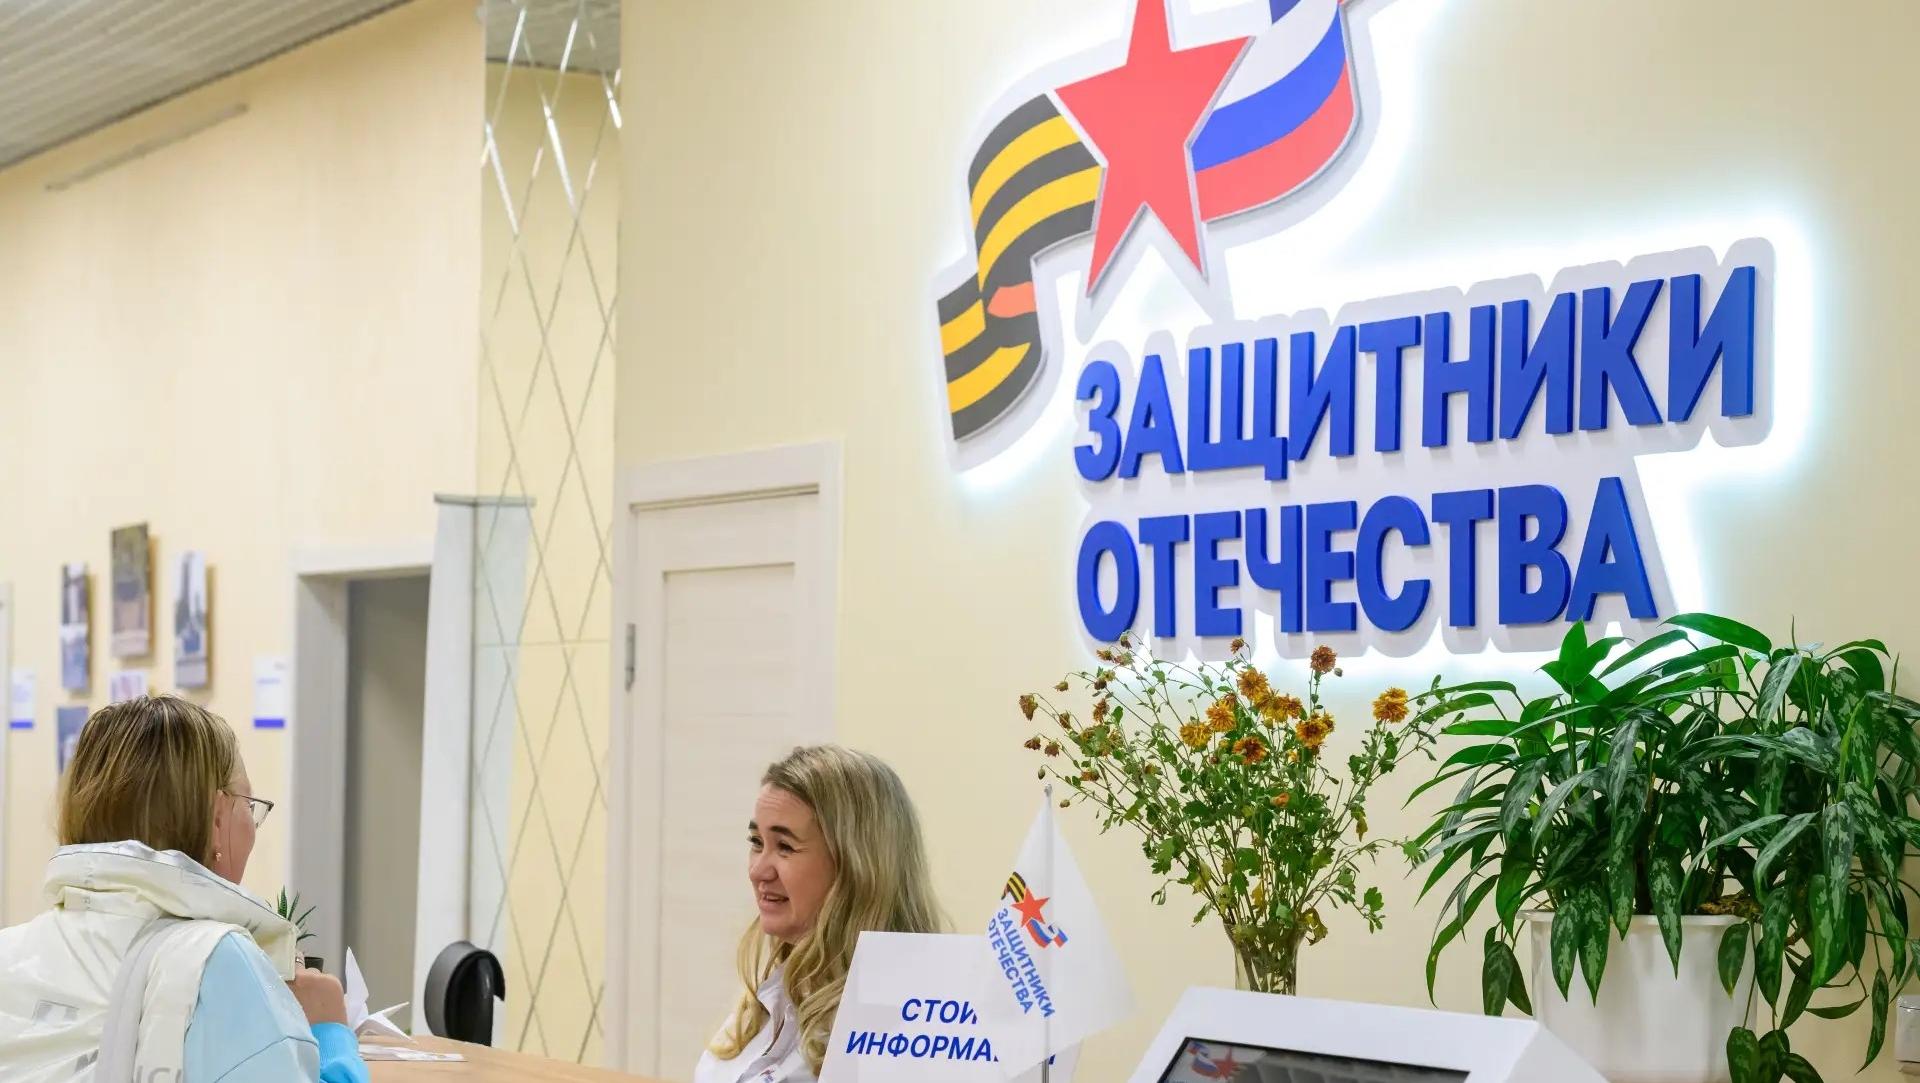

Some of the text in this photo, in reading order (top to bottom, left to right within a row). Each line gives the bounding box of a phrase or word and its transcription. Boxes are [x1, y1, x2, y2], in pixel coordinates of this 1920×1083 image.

[1074, 265, 1755, 482] ЗАЩИТНИКИ
[1077, 476, 1659, 642] ОТЕЧЕСТВА
[998, 908, 1055, 1018] ЗАЩИТНИКИ
[846, 1031, 1056, 1065] ИНФОРМА
